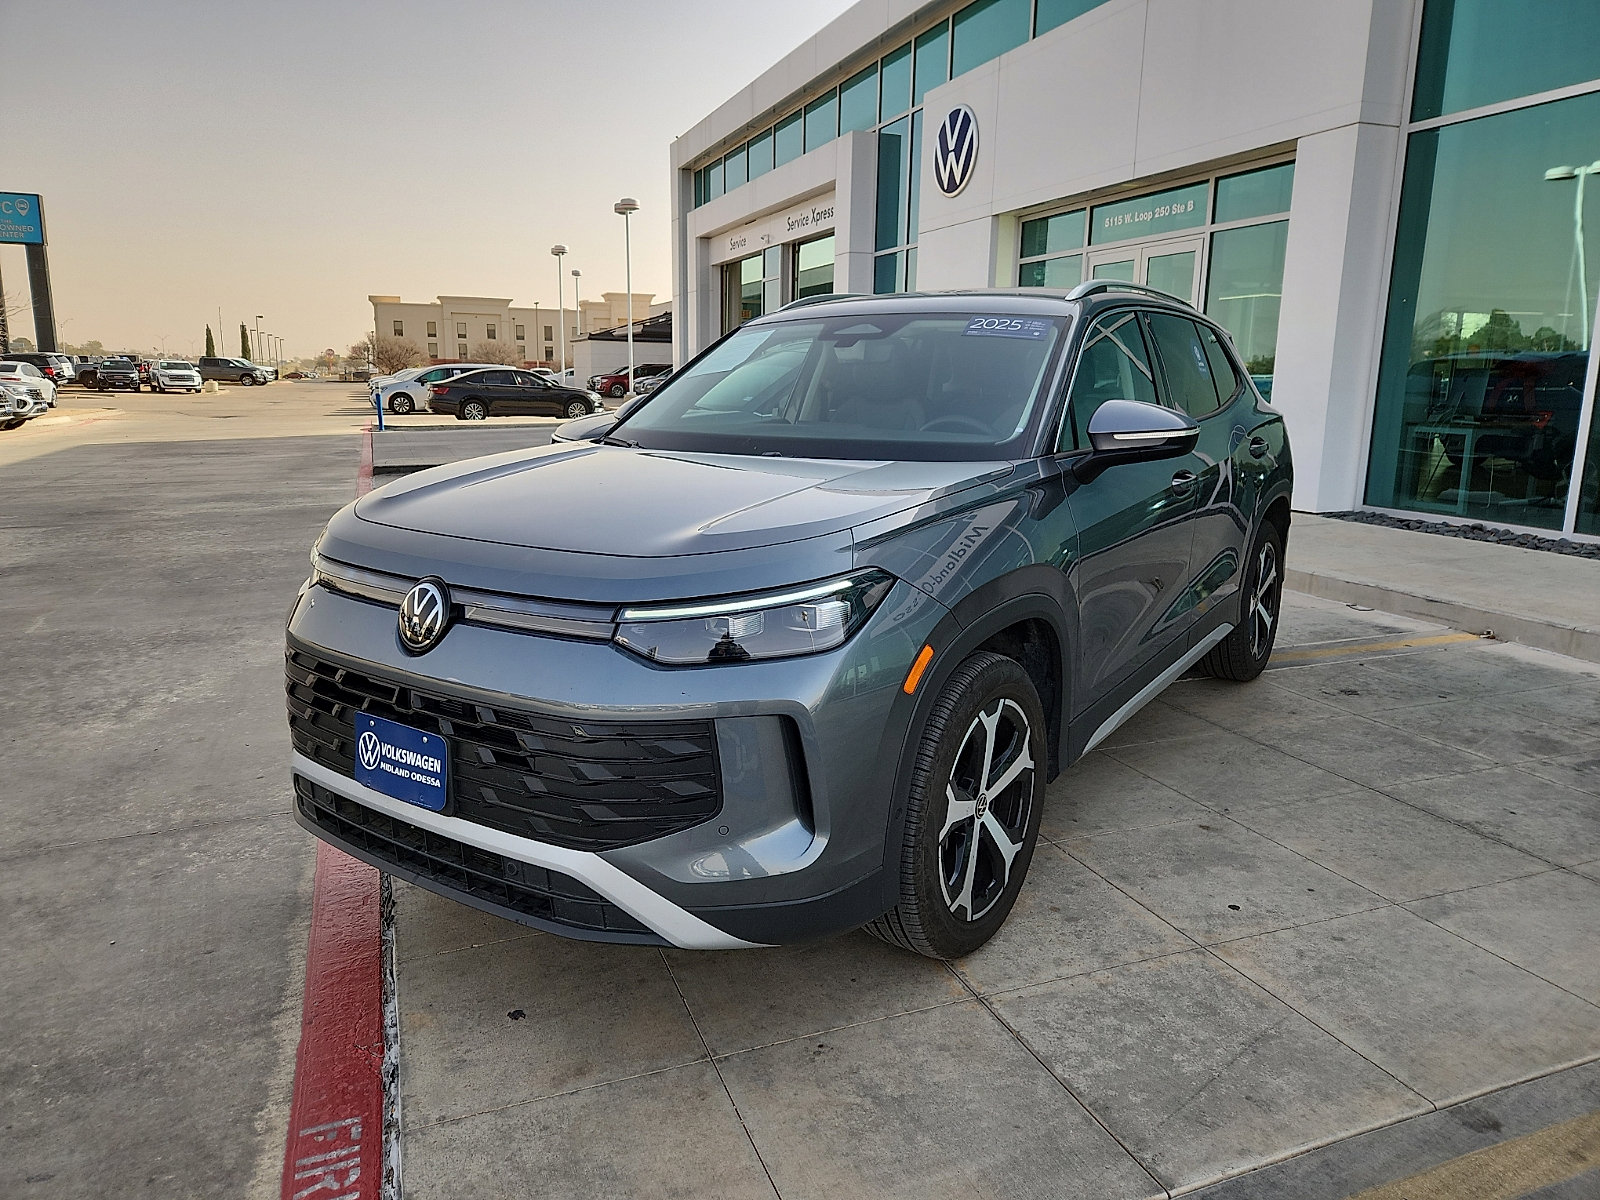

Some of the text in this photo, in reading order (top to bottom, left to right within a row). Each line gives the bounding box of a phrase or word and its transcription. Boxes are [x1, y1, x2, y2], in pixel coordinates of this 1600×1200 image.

[787, 206, 834, 231] Service Xpress
[1105, 200, 1194, 227] 5115 W. Loop 250 Ste B
[729, 236, 747, 251] Service
[969, 318, 1024, 331] 2025
[381, 741, 442, 774] VOLKSWAGEN
[380, 761, 441, 788] MIDLAND ODESSA
[293, 1116, 362, 1200] FIR
